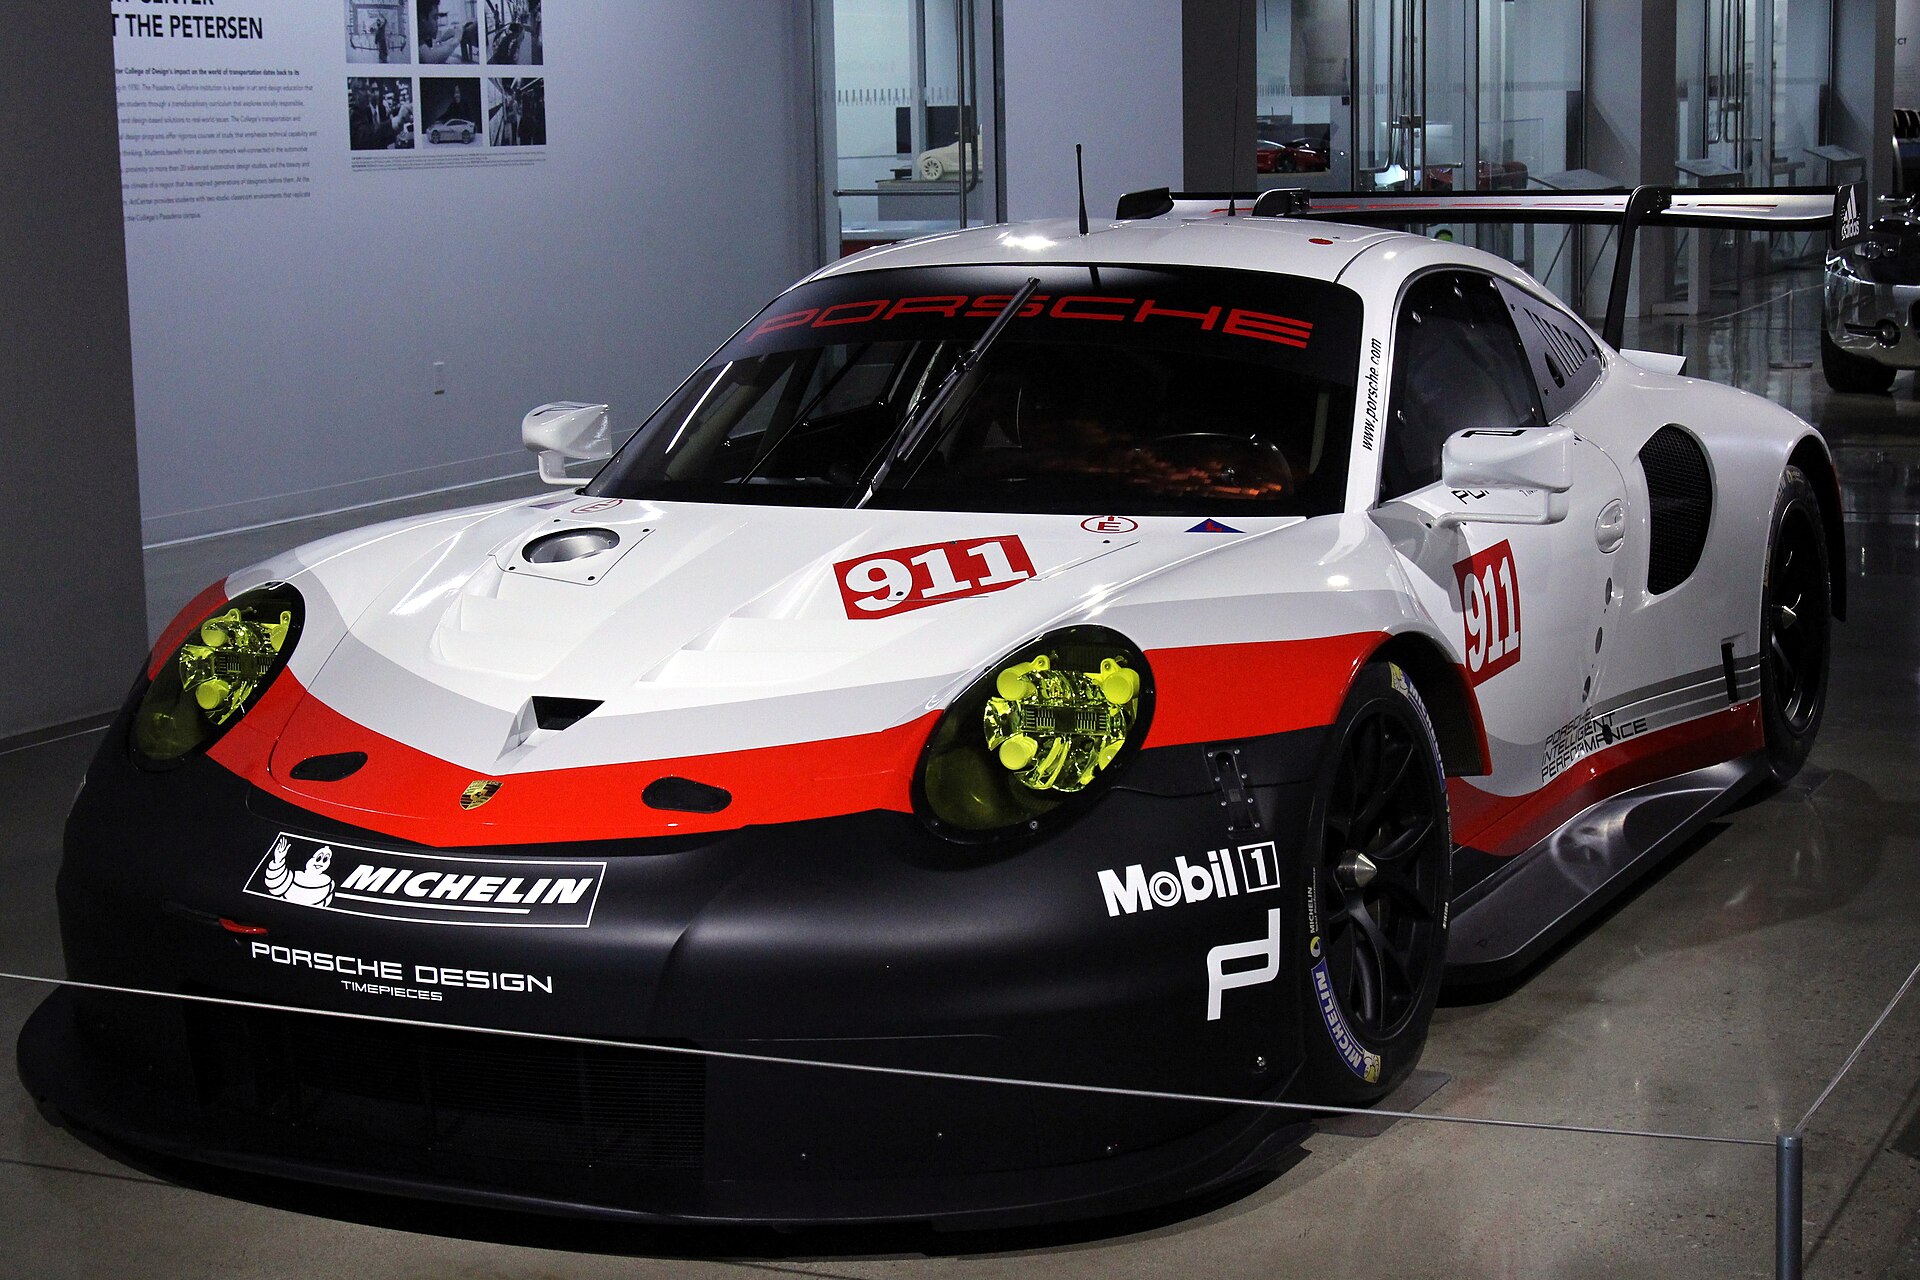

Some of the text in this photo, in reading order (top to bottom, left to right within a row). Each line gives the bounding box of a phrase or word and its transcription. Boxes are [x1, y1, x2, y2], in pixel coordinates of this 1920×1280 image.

[112, 14, 263, 39] T THE PETERSEN
[125, 67, 143, 76] College
[152, 67, 172, 76] Design's
[174, 68, 190, 76] impact
[745, 294, 1313, 349] PORSCHE
[1362, 338, 1381, 451] www.porsche.com
[845, 541, 1029, 612] 911
[1464, 556, 1519, 673] 911
[1541, 712, 1616, 766] INTELLIGENT
[1545, 706, 1593, 745] PORSCHE
[340, 864, 593, 904] MICHELIN
[1097, 848, 1238, 917] Mobil
[1307, 887, 1316, 934] MICHELIN
[252, 941, 553, 994] PORSCHE DESIGN
[341, 980, 443, 1001] TIMEPIECES
[1315, 970, 1360, 1069] MICHELIN
